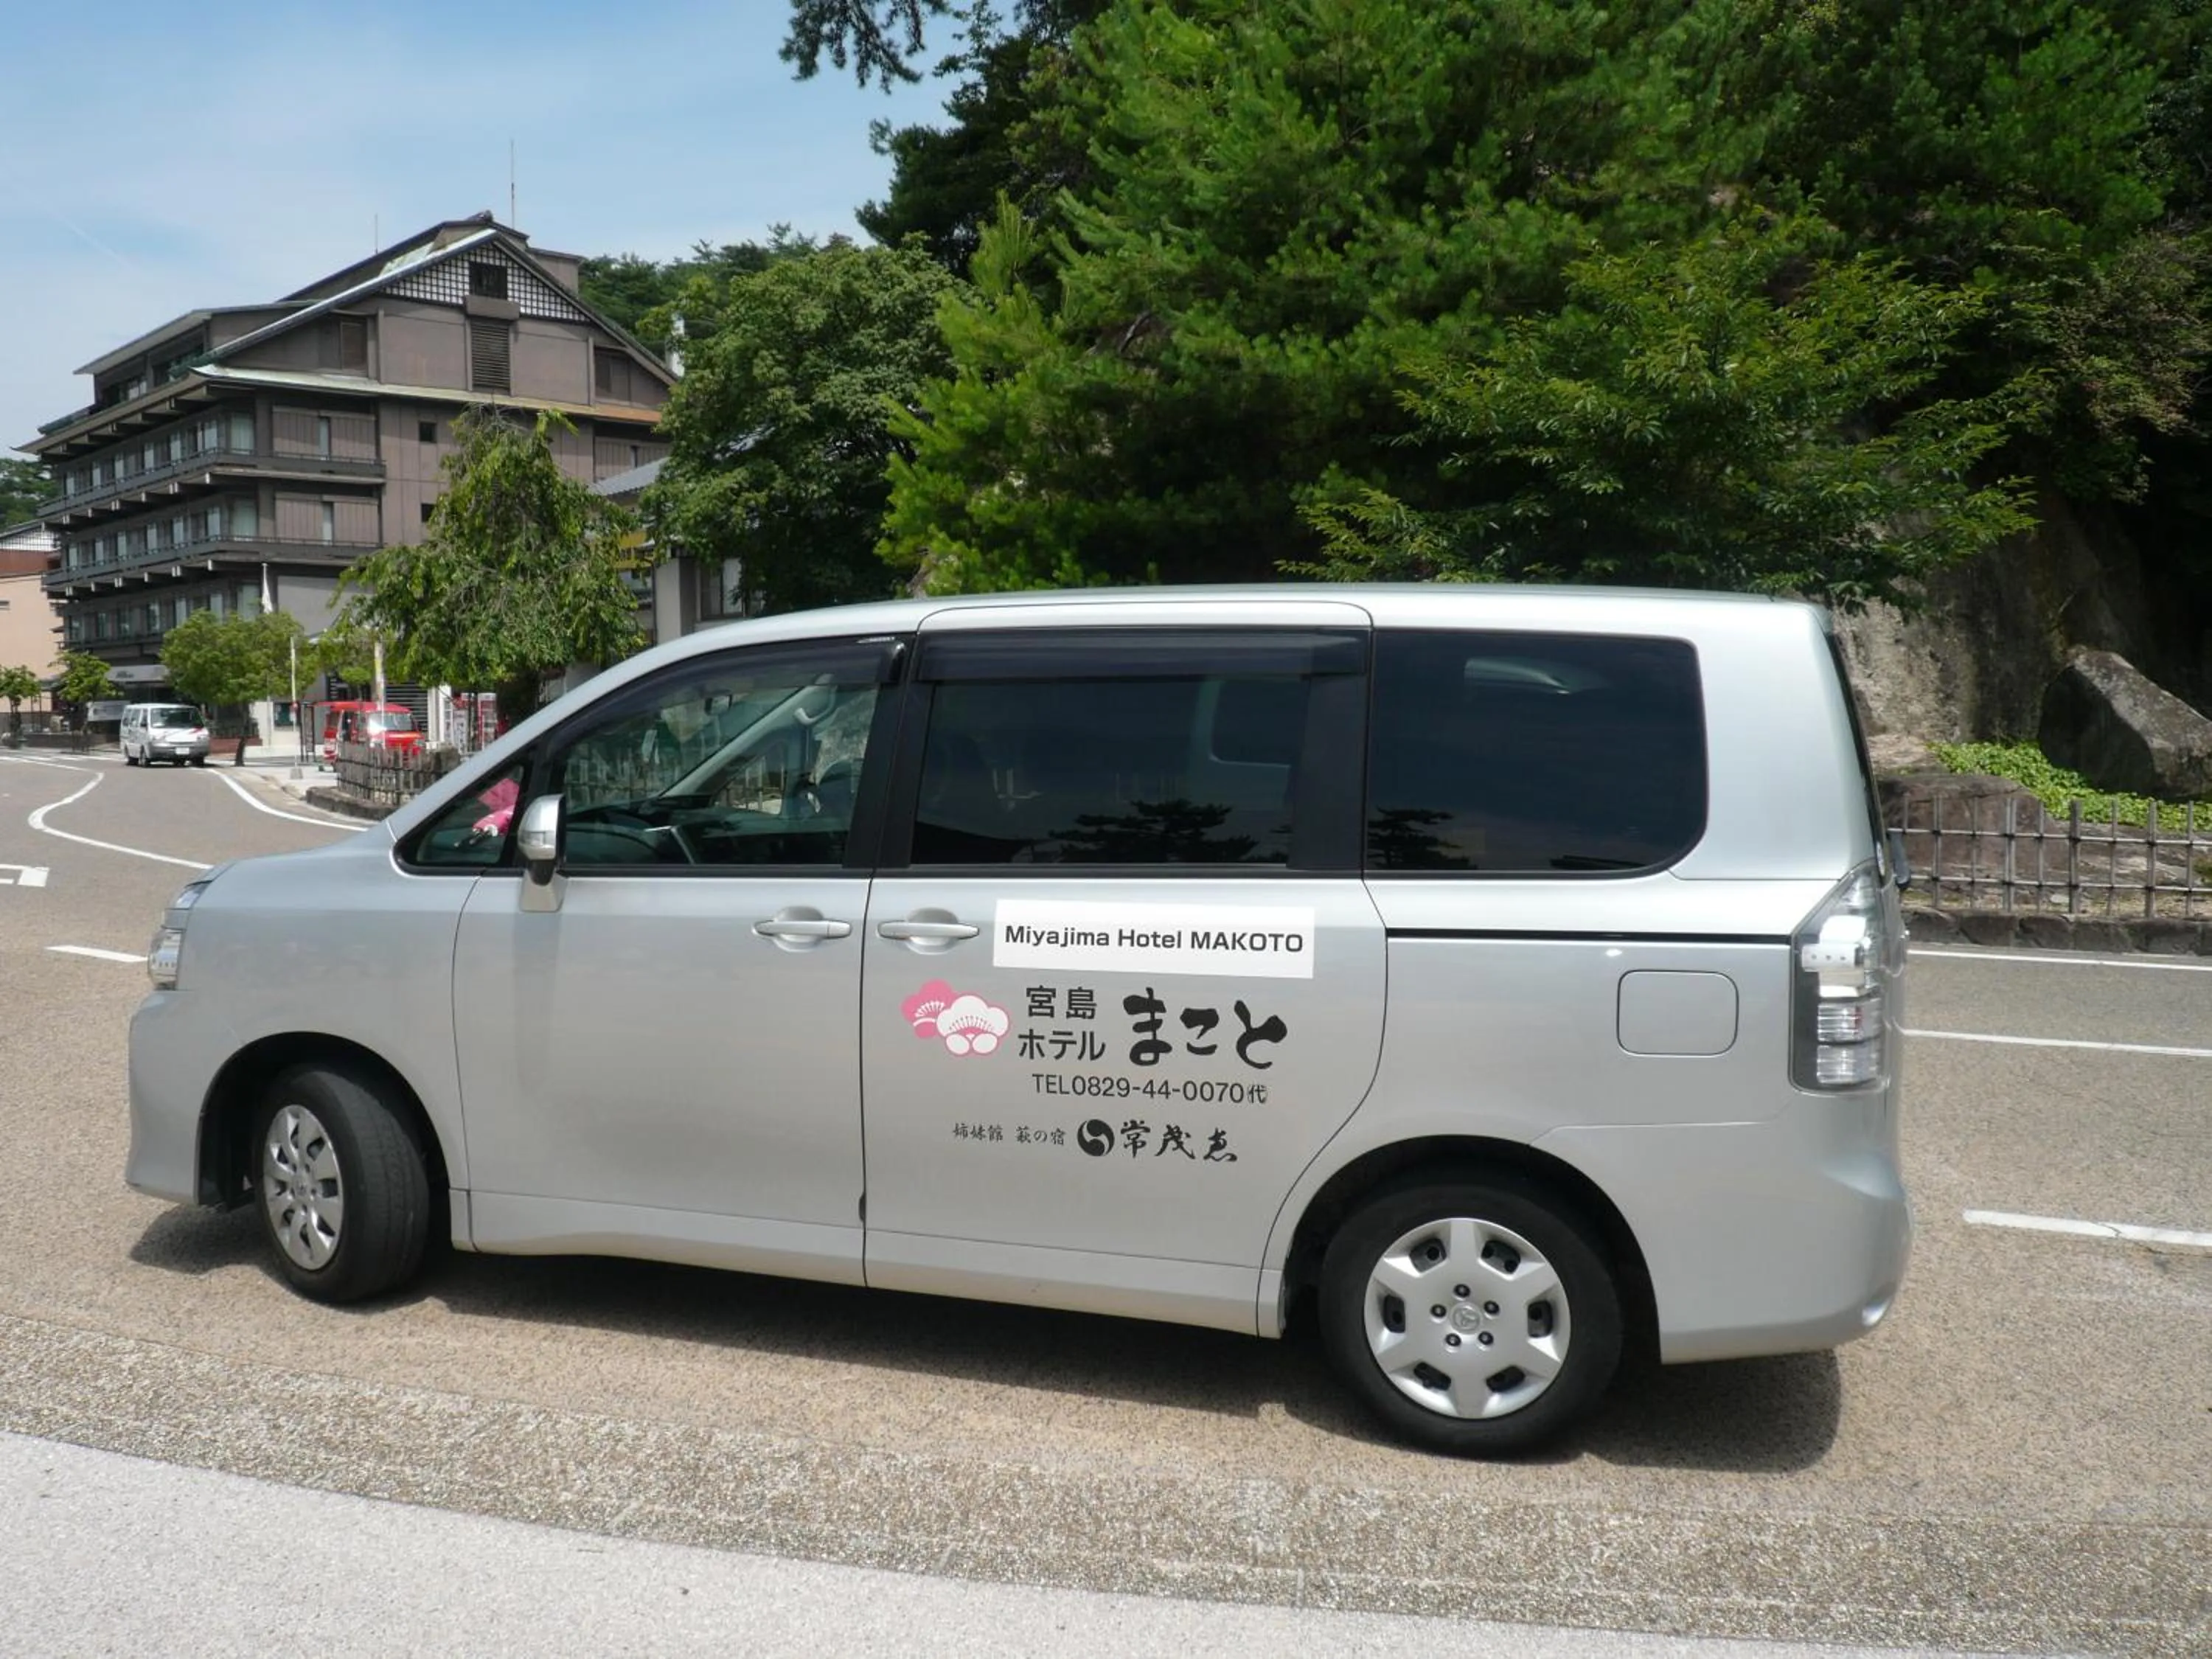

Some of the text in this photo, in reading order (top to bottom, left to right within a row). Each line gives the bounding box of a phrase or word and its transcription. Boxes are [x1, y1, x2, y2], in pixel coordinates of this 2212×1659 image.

[1005, 925, 1303, 953] Miyajima Hotel MAKOTO
[1026, 985, 1097, 1020] 宮島
[1018, 1029, 1107, 1062] ホテル
[1123, 987, 1288, 1070] まこと
